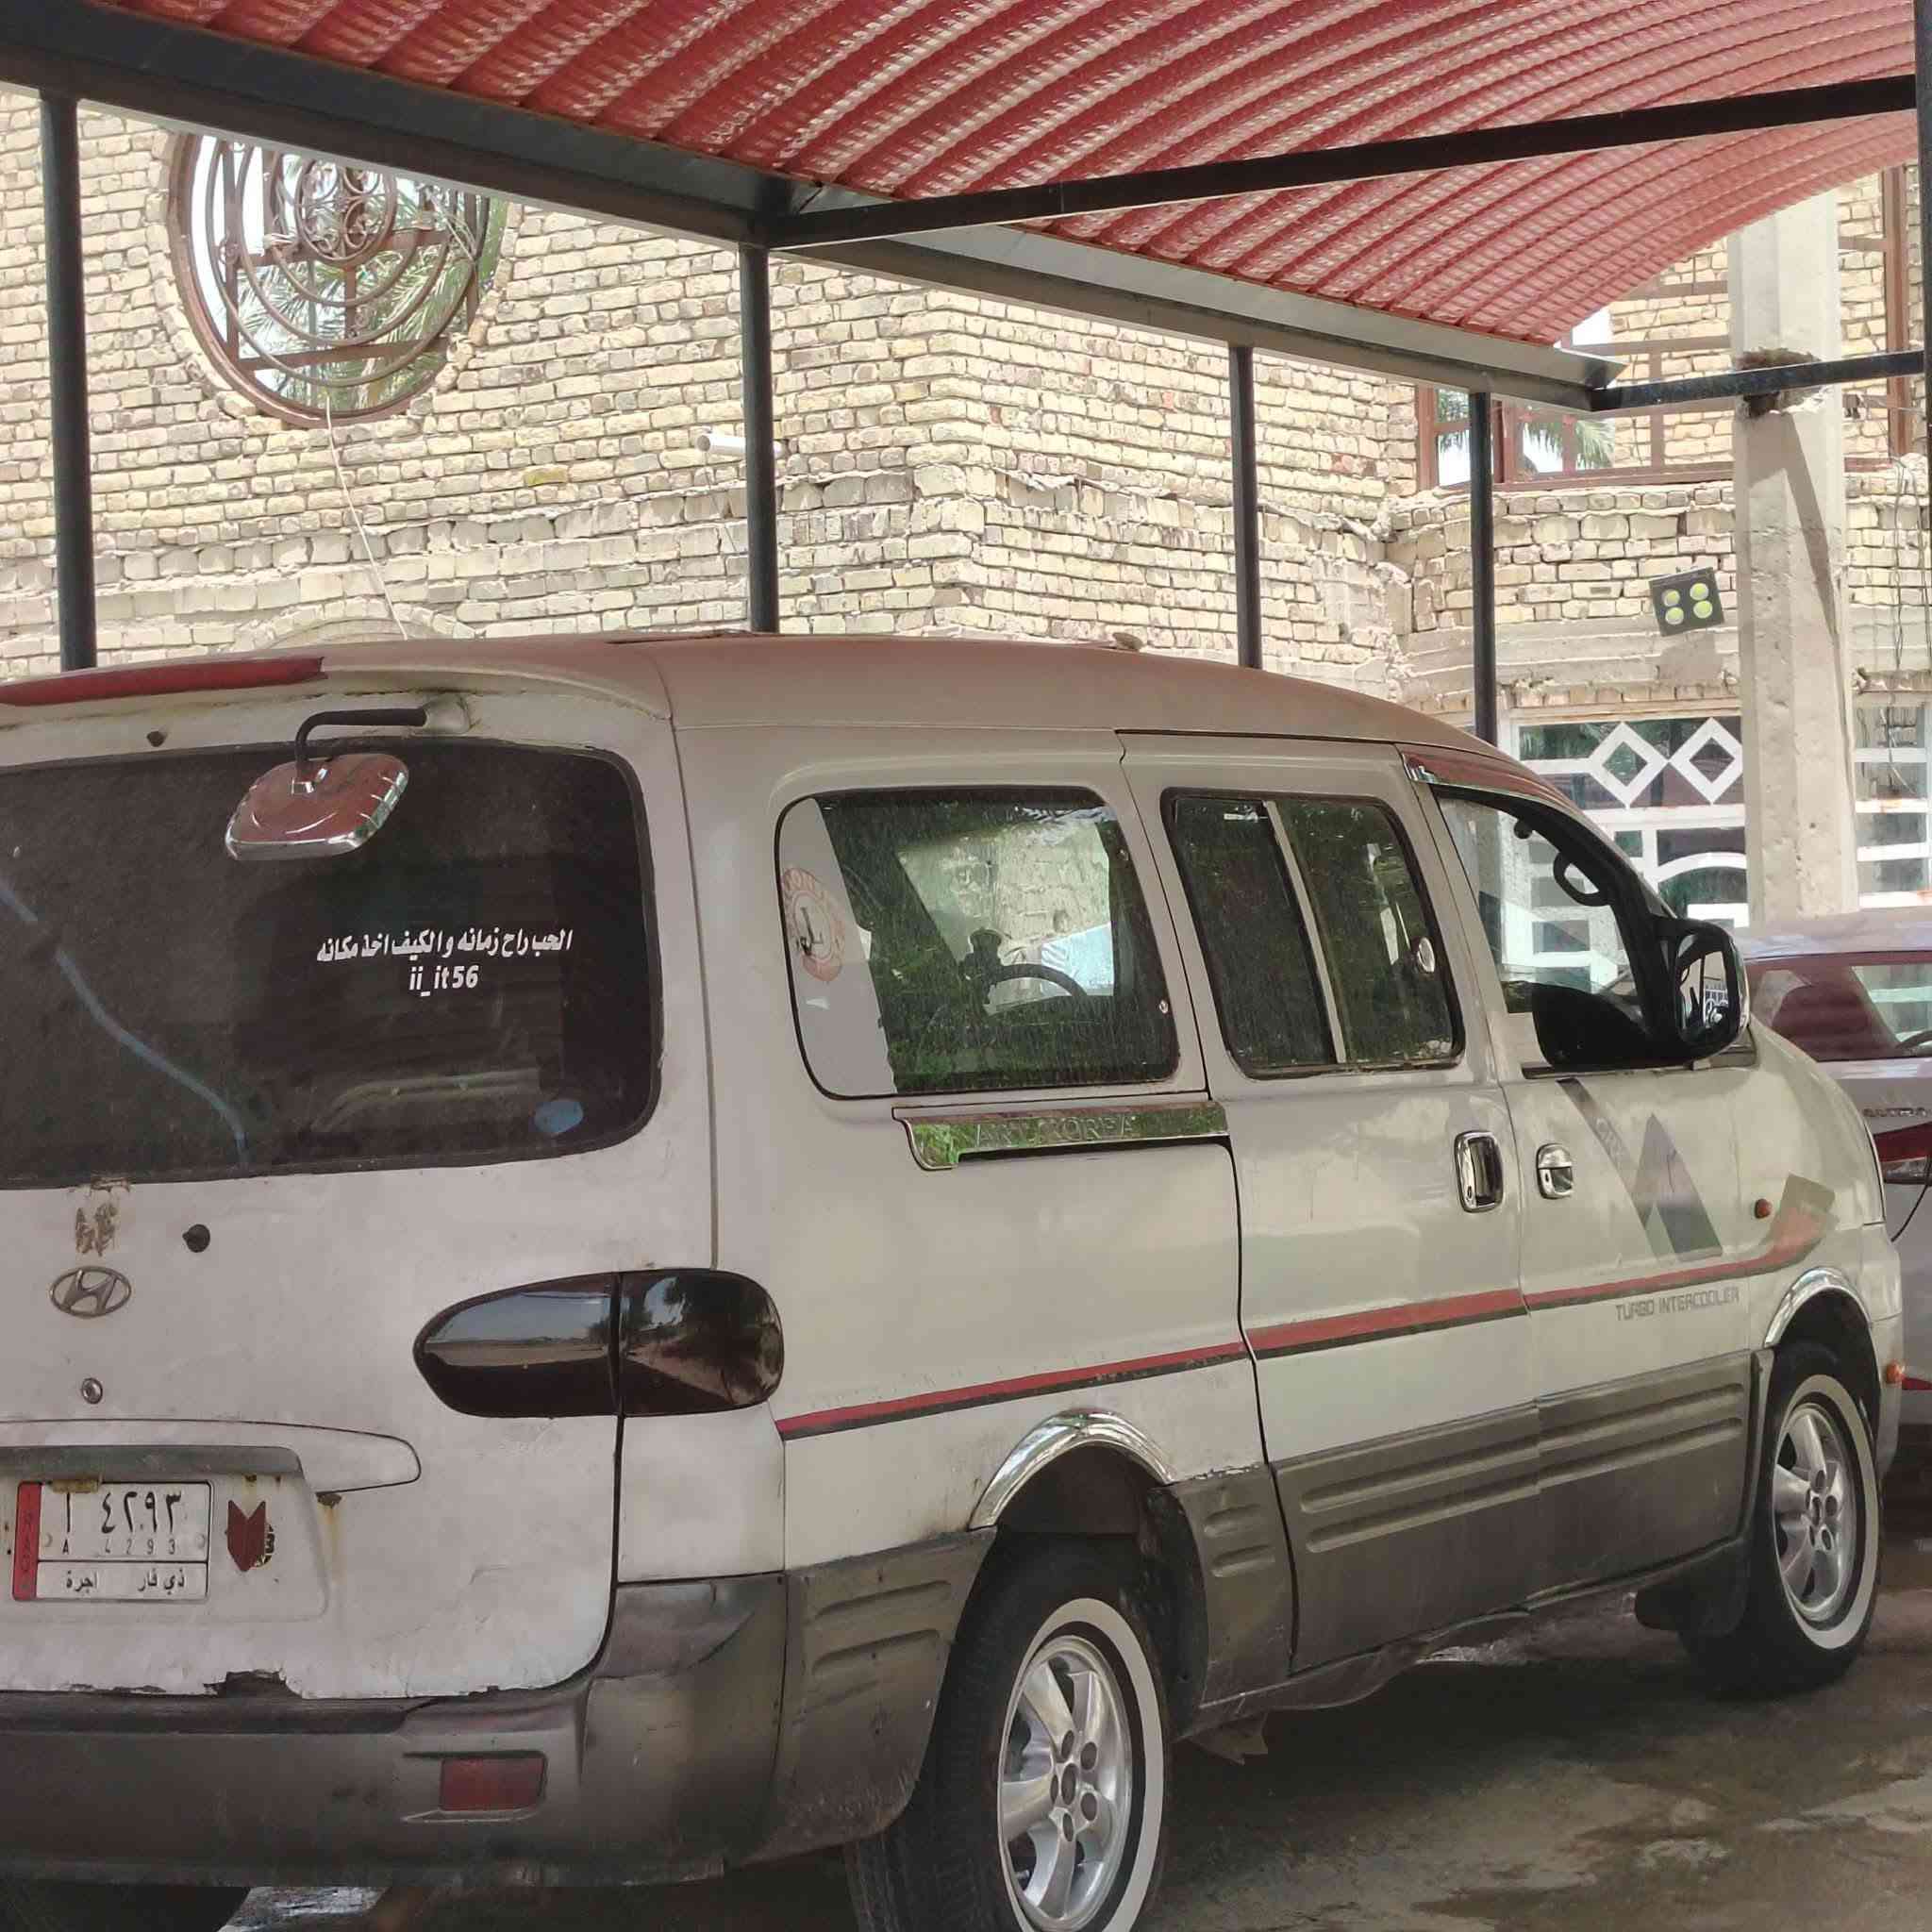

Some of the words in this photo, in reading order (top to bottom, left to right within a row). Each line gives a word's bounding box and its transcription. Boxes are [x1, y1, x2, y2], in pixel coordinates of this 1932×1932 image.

[316, 935, 358, 962] مكانه
[457, 926, 500, 957] زمانه
[501, 928, 529, 958] راح
[531, 928, 574, 958] الحب
[1615, 1299, 1655, 1322] TURBO
[1658, 1285, 1740, 1315] INTERCOOLER
